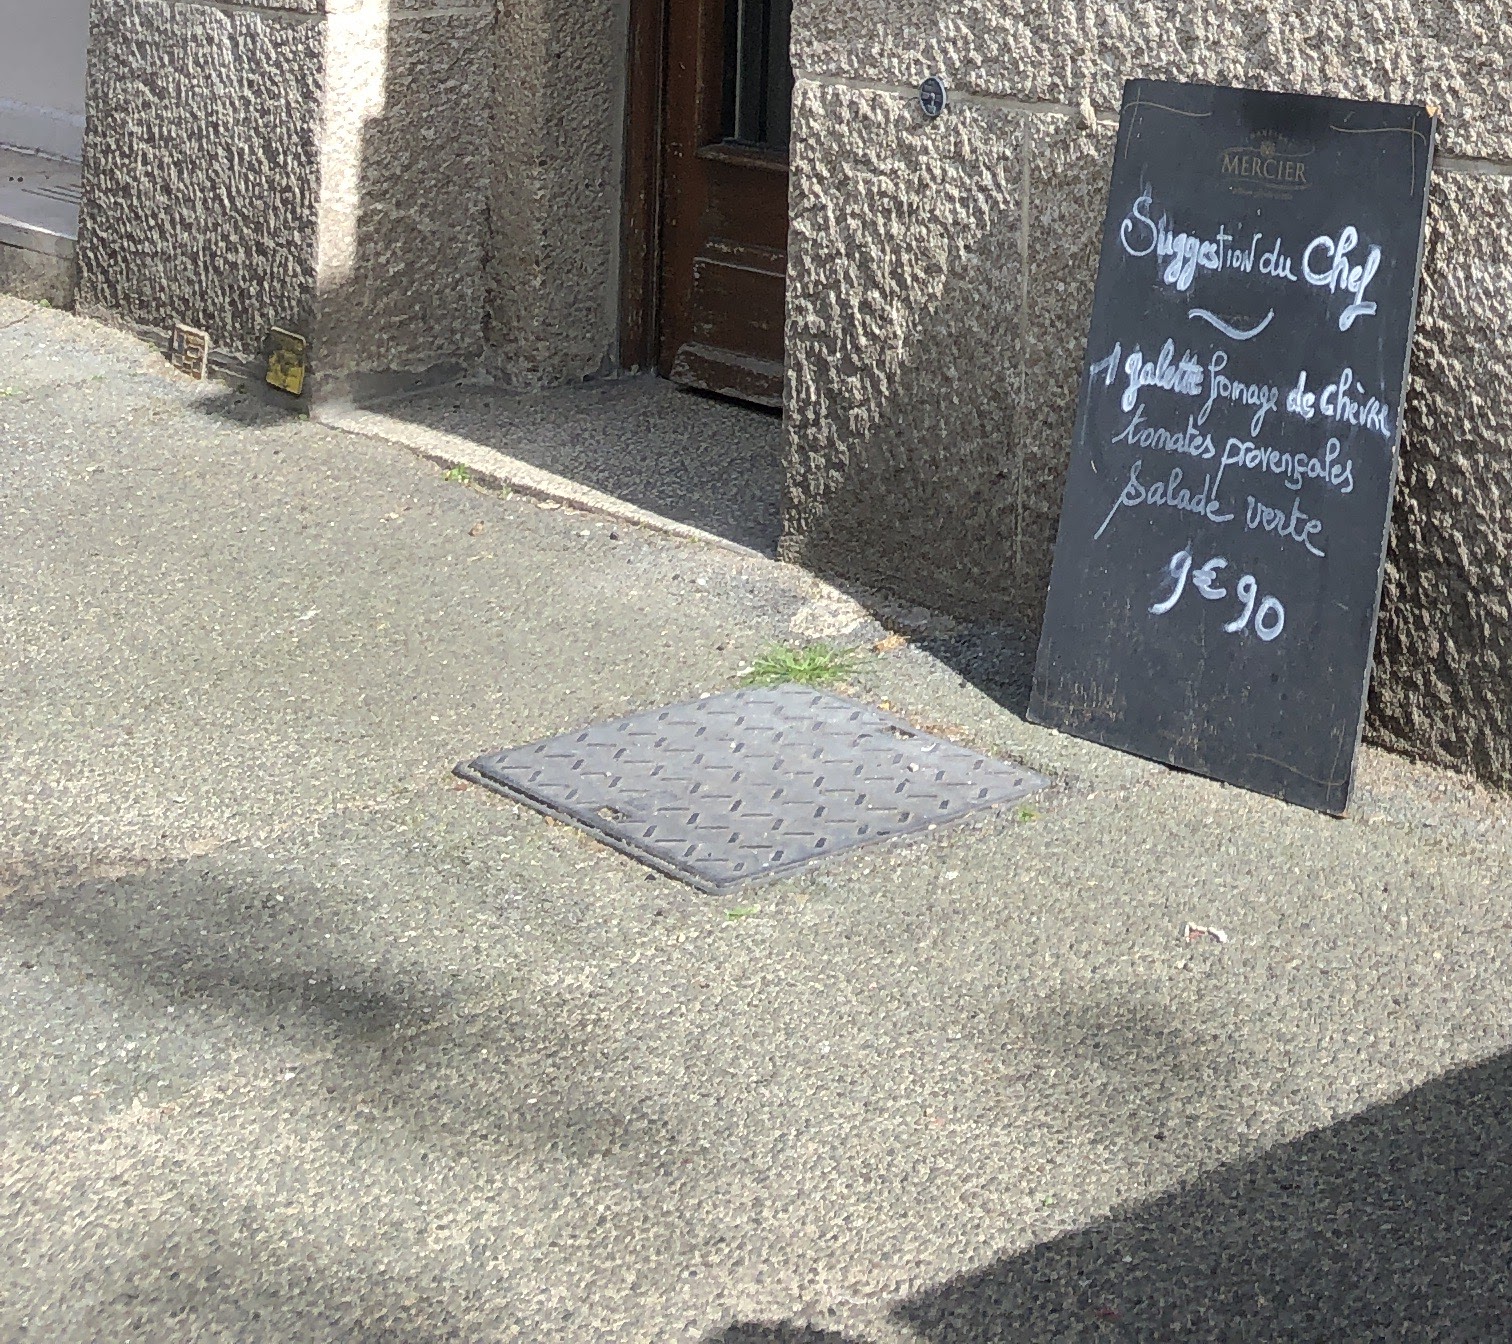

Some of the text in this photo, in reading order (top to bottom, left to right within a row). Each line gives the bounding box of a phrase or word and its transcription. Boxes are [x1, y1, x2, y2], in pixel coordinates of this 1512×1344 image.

[1222, 154, 1307, 183] MERCIER
[1121, 196, 1382, 332] Suggestion du Chef
[1122, 338, 1204, 412] galette
[1198, 350, 1278, 437] fromage
[1286, 370, 1315, 418] de
[1112, 404, 1354, 500] tomates provençales
[1246, 495, 1326, 558] verte
